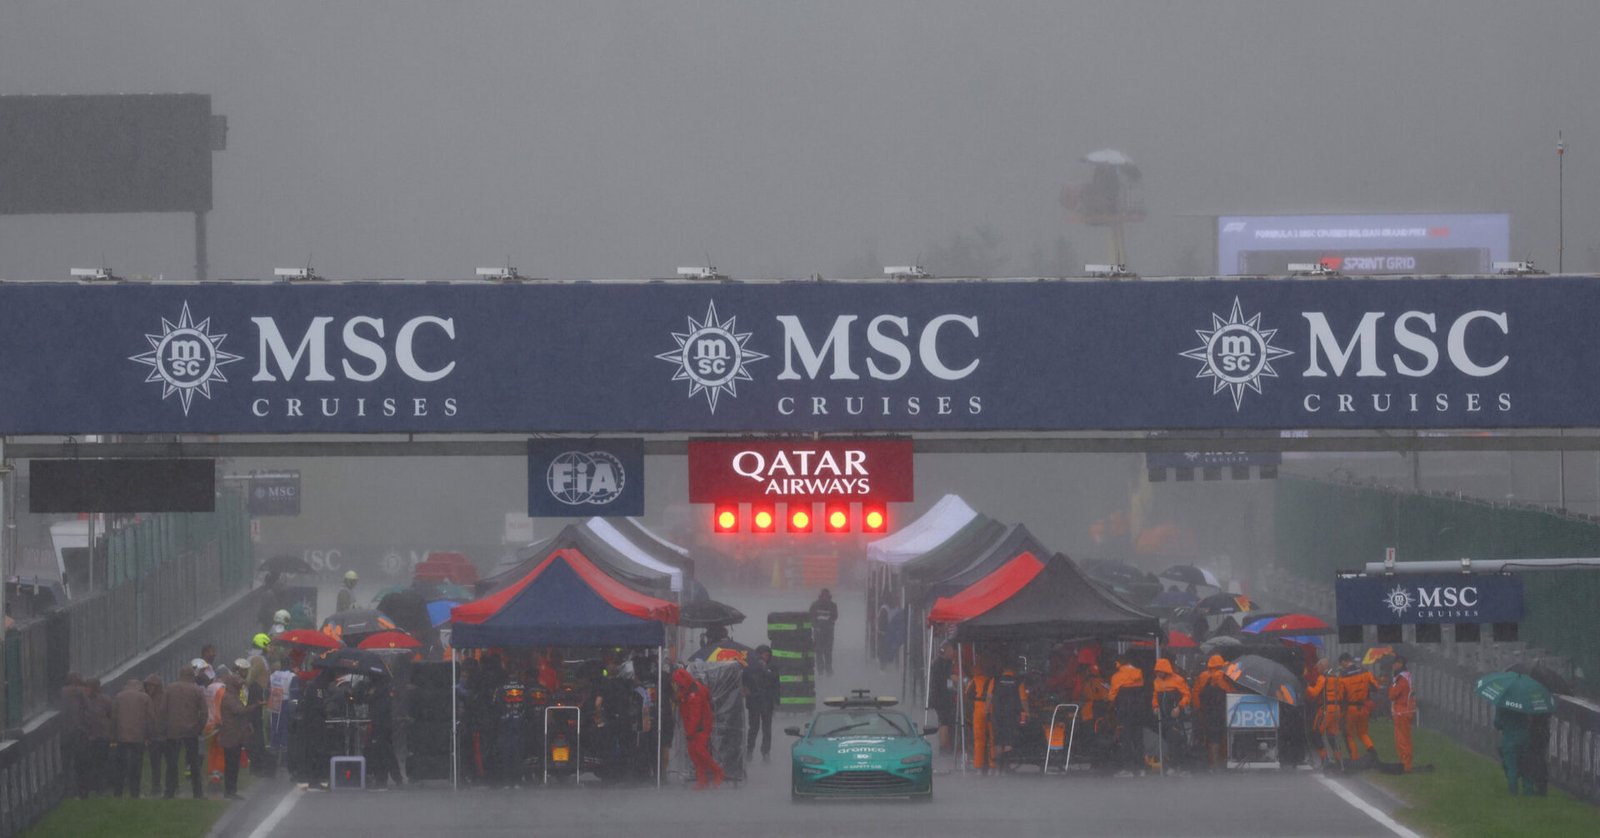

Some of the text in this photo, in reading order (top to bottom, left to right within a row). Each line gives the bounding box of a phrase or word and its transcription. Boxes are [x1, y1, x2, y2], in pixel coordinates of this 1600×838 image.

[1344, 257, 1415, 270] SPRINT GRID
[251, 316, 455, 382] MSC
[777, 314, 980, 381] MSC
[1302, 310, 1510, 377] MSC
[252, 399, 457, 417] CRUISES
[778, 396, 982, 415] CRUISES
[1304, 393, 1511, 412] CRUISES
[732, 450, 869, 482] QATAR
[268, 486, 296, 497] MSC
[765, 478, 870, 495] AIRWAYS
[304, 549, 342, 570] SC
[1417, 586, 1478, 608] MSC
[1418, 610, 1479, 618] CRUISES
